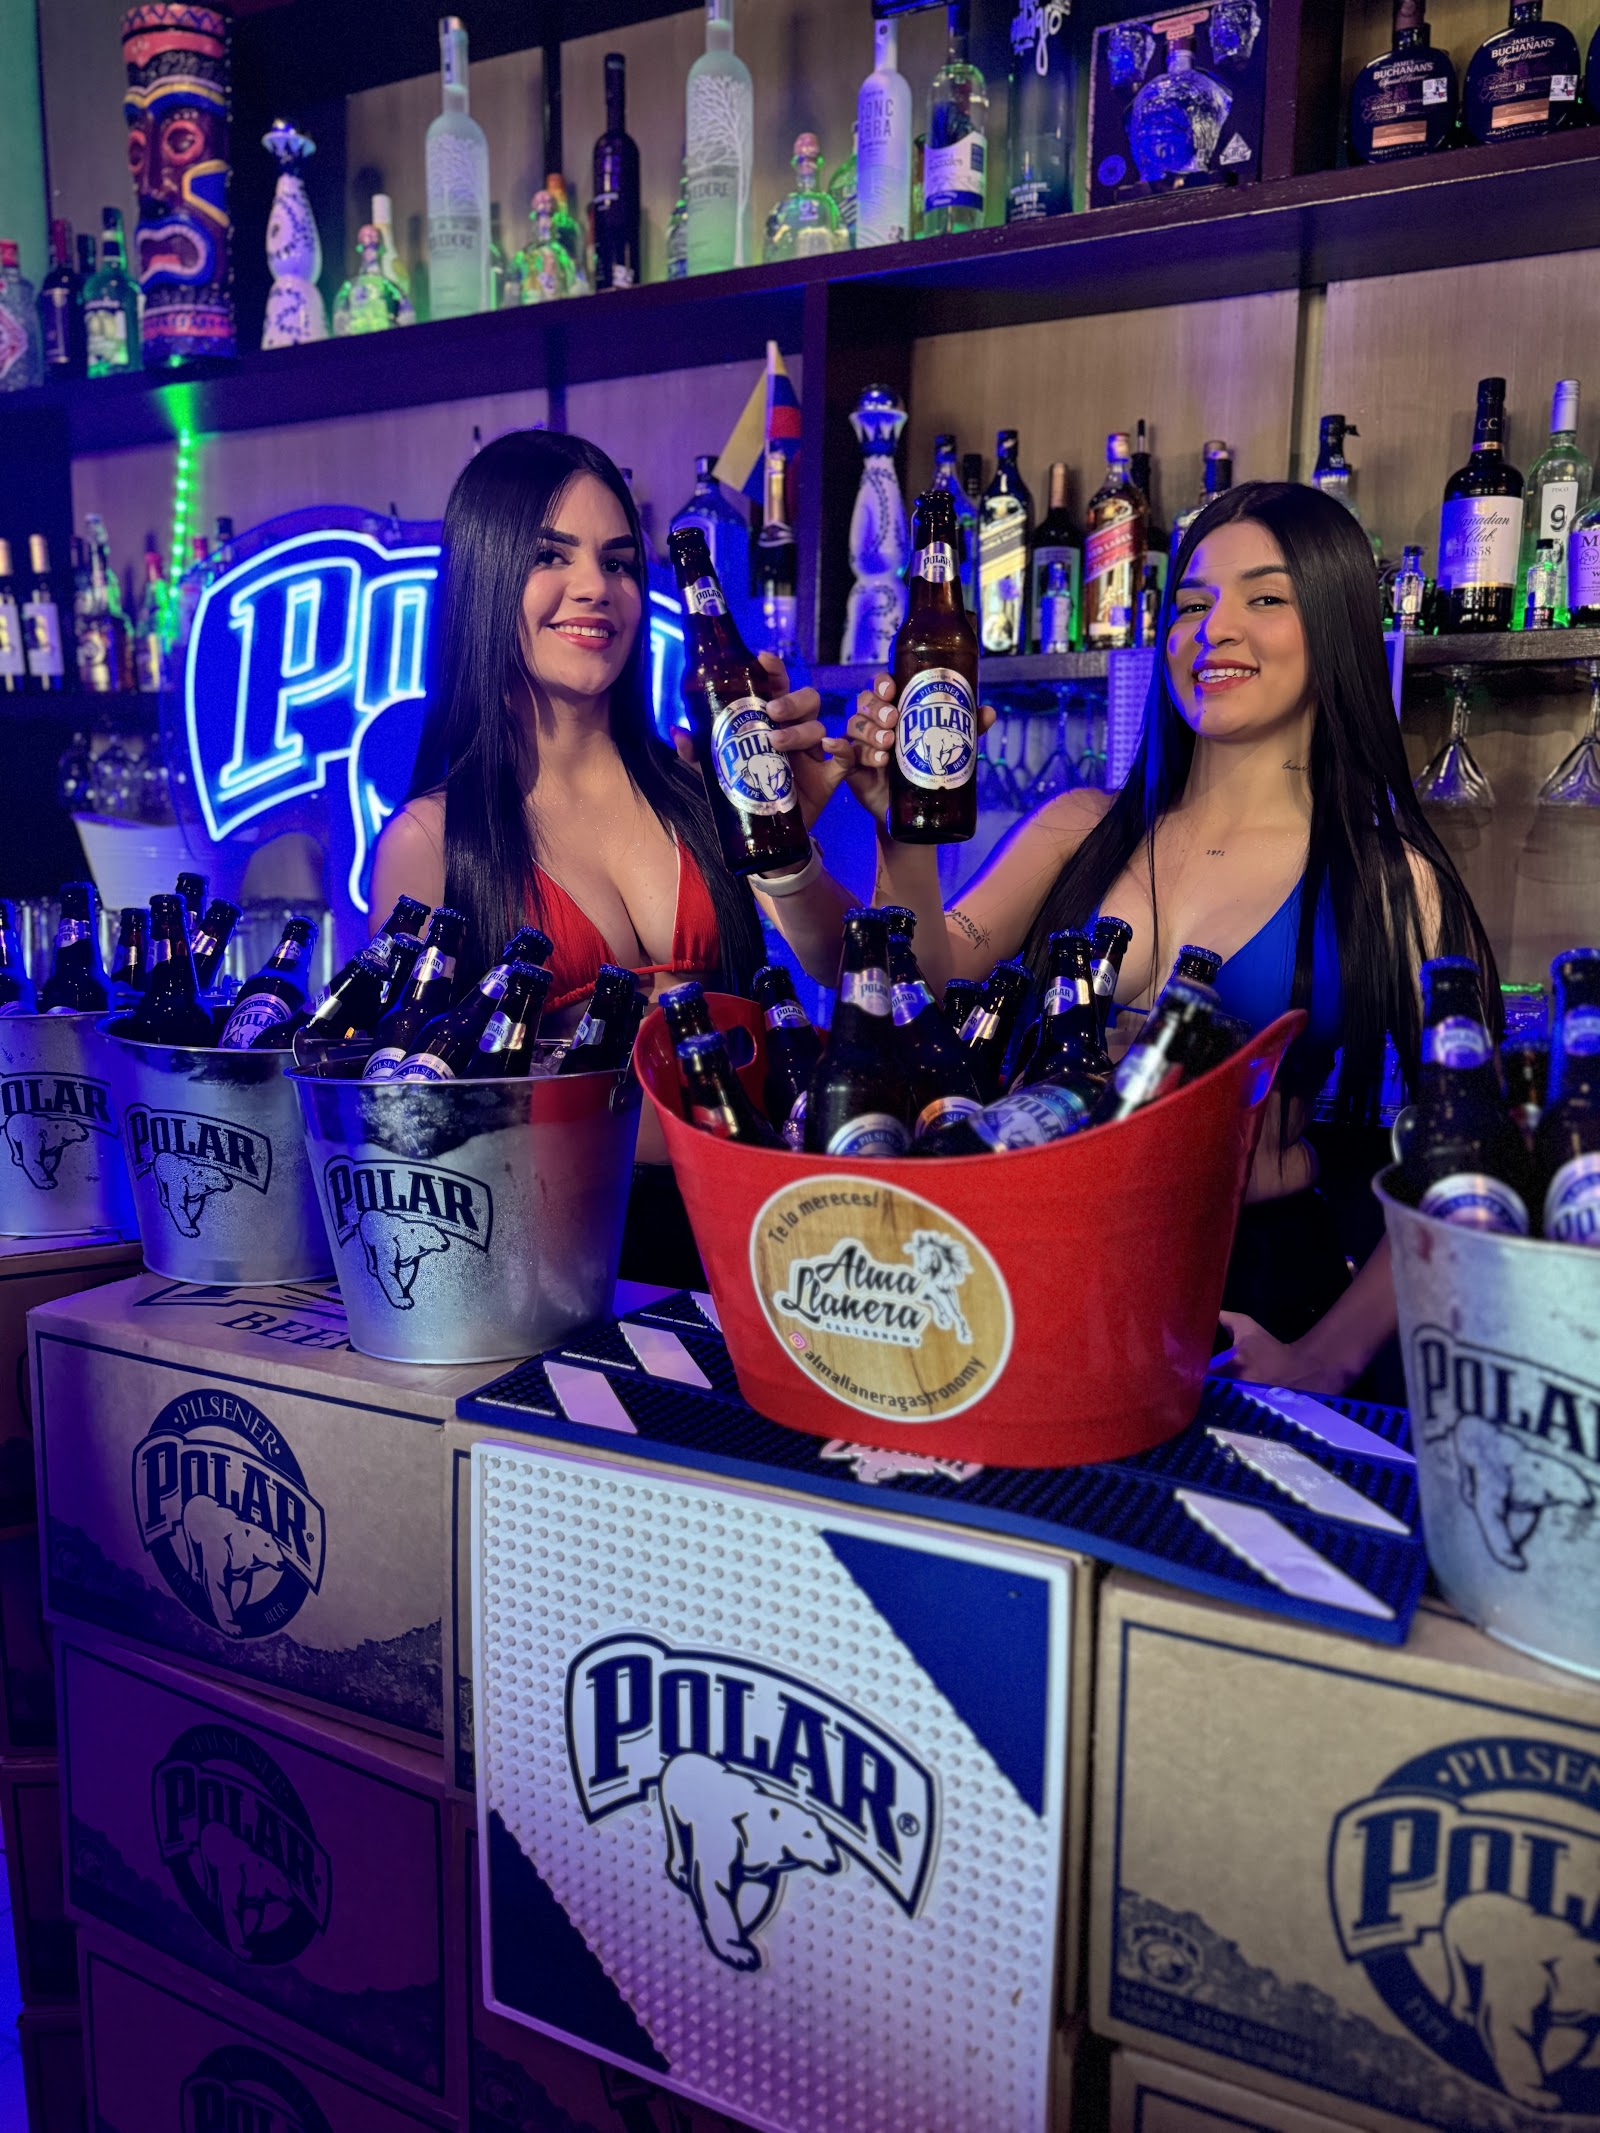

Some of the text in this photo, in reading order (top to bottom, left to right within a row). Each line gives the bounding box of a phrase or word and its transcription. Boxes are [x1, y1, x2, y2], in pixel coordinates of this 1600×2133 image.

[1491, 38, 1555, 58] BUCHANAN'S
[1511, 36, 1535, 45] JAMES
[1392, 59, 1415, 68] JAMES
[1497, 50, 1548, 67] Special Reserve
[1373, 62, 1434, 80] BUCHANAN'S
[1378, 73, 1427, 88] Special Reserve
[1515, 83, 1526, 93] 18
[1396, 104, 1406, 114] 18
[1552, 486, 1569, 494] PISCO
[1456, 510, 1511, 526] Canadian
[1550, 504, 1567, 532] 9
[1103, 532, 1133, 552] LABEL
[1465, 545, 1492, 557] 1858
[922, 554, 951, 571] POLAR
[696, 585, 724, 604] POLAR
[920, 683, 960, 699] PILSENER
[733, 712, 770, 729] PILSENER
[902, 706, 972, 745] POLAR
[911, 753, 968, 770] TYPE BEER
[741, 784, 760, 799] TYPE
[371, 938, 390, 955] POLAR
[488, 971, 508, 987] POLA
[892, 992, 916, 1008] OLAR
[776, 1004, 805, 1020] POLAR
[372, 1060, 400, 1072] PILSEN
[408, 1066, 439, 1080] PILSEN
[0, 1079, 111, 1124] OLAR
[129, 1111, 260, 1178] POLAR
[328, 1164, 481, 1234] POLAR
[768, 1191, 879, 1244] Te lo mereces!
[816, 1245, 924, 1297] Alma
[781, 1266, 926, 1331] Llanera
[826, 1322, 921, 1345] GASTRONOMY
[805, 1356, 987, 1412] almallaneragastronomy
[1419, 1339, 1600, 1464] POLA
[178, 1396, 278, 1457] PILSENER
[142, 1442, 312, 1567] POLAR
[264, 1601, 289, 1625] BEER
[586, 1653, 903, 1867] POLAR
[1446, 1745, 1600, 1792] PILSEN
[163, 1766, 319, 1901] POLAR
[1353, 1808, 1600, 1944] POL
